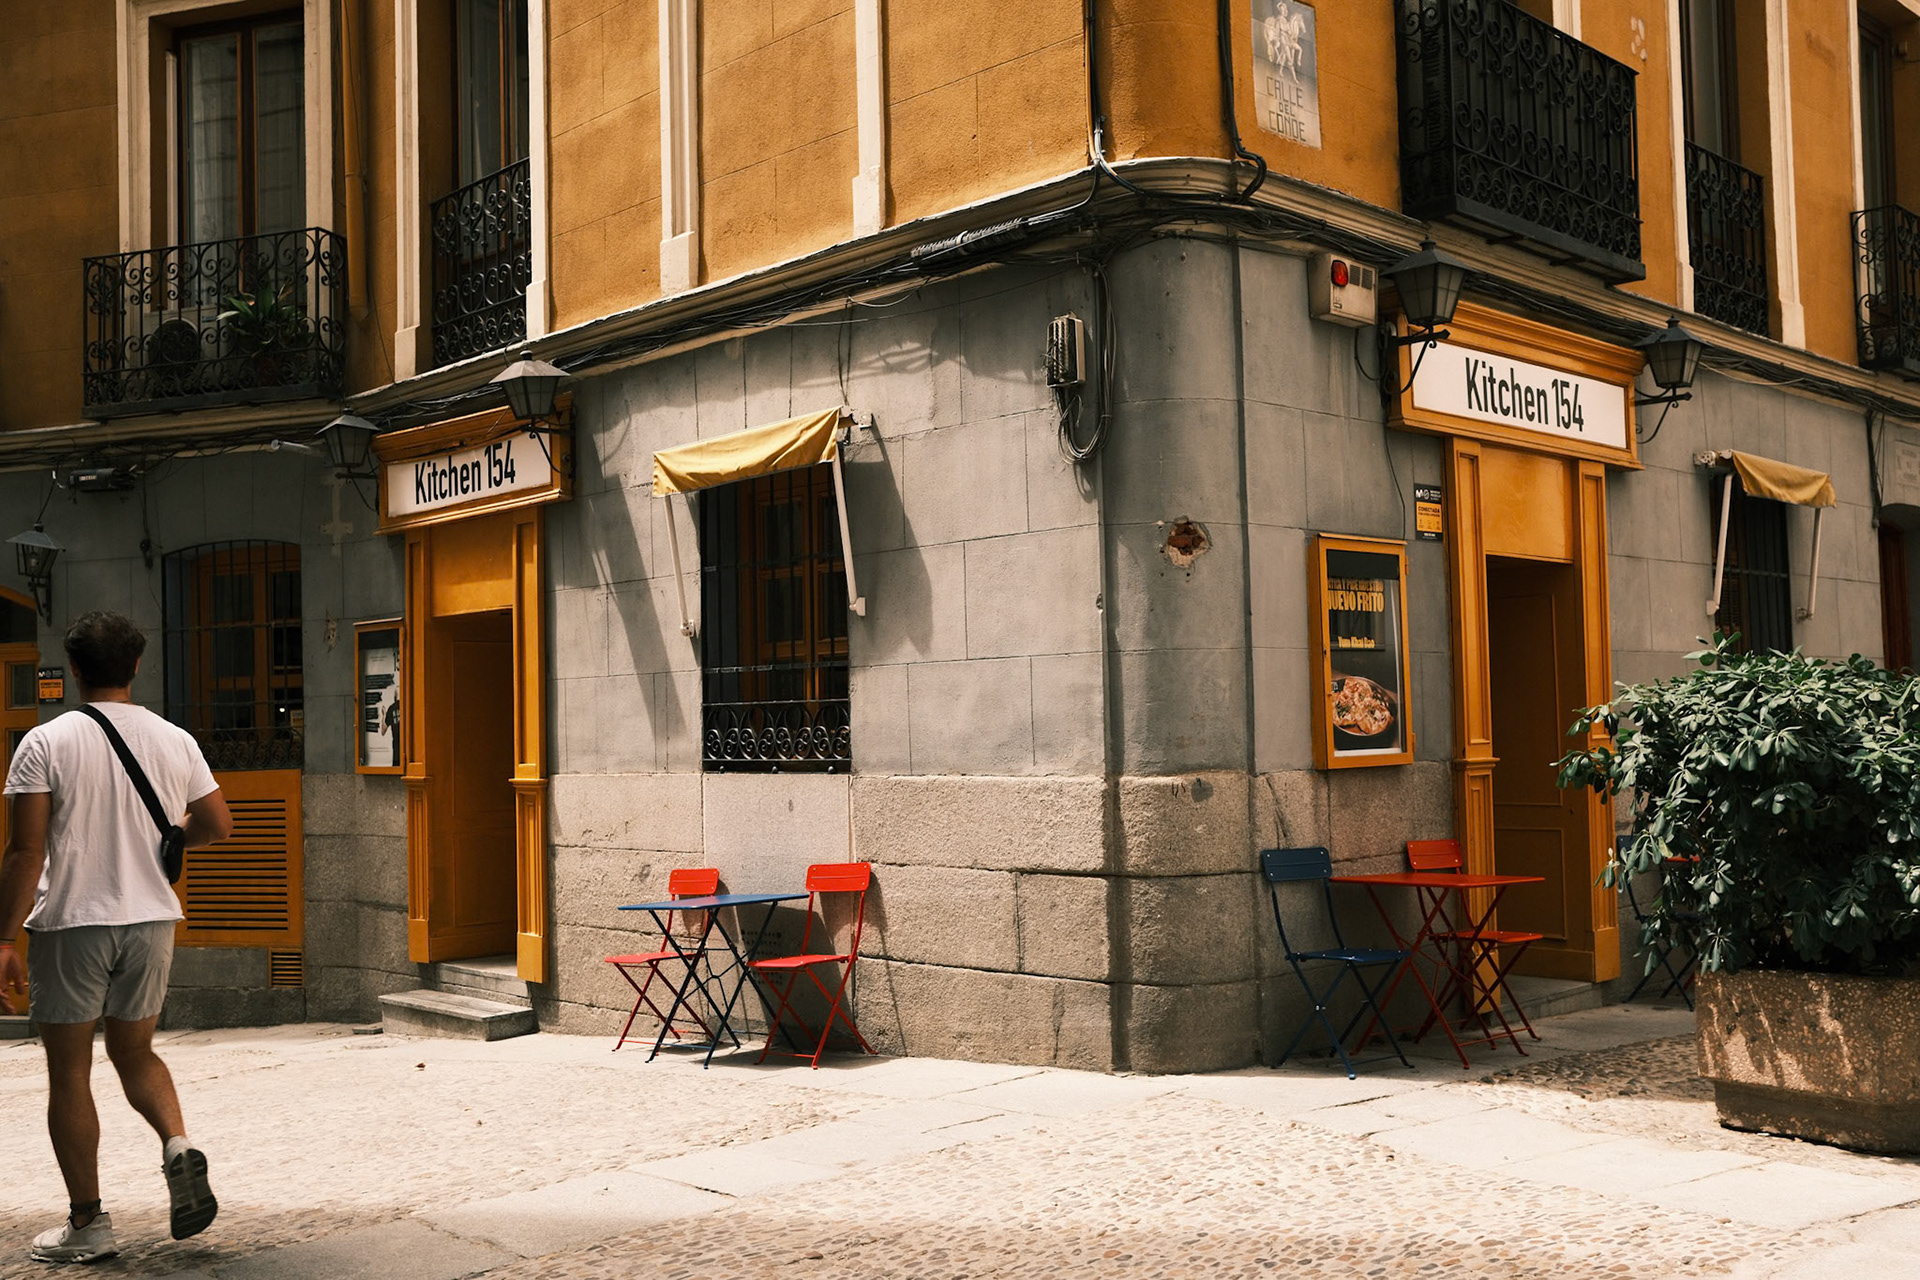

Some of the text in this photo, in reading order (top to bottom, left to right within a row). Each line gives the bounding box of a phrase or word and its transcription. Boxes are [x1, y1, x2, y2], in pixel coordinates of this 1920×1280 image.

[1266, 76, 1303, 108] CALLE
[1278, 102, 1295, 117] DEL
[1268, 110, 1306, 142] CONDE
[1465, 357, 1584, 432] Kitchen 154
[415, 440, 516, 505] Kitchen 154
[1357, 591, 1385, 612] FRITO
